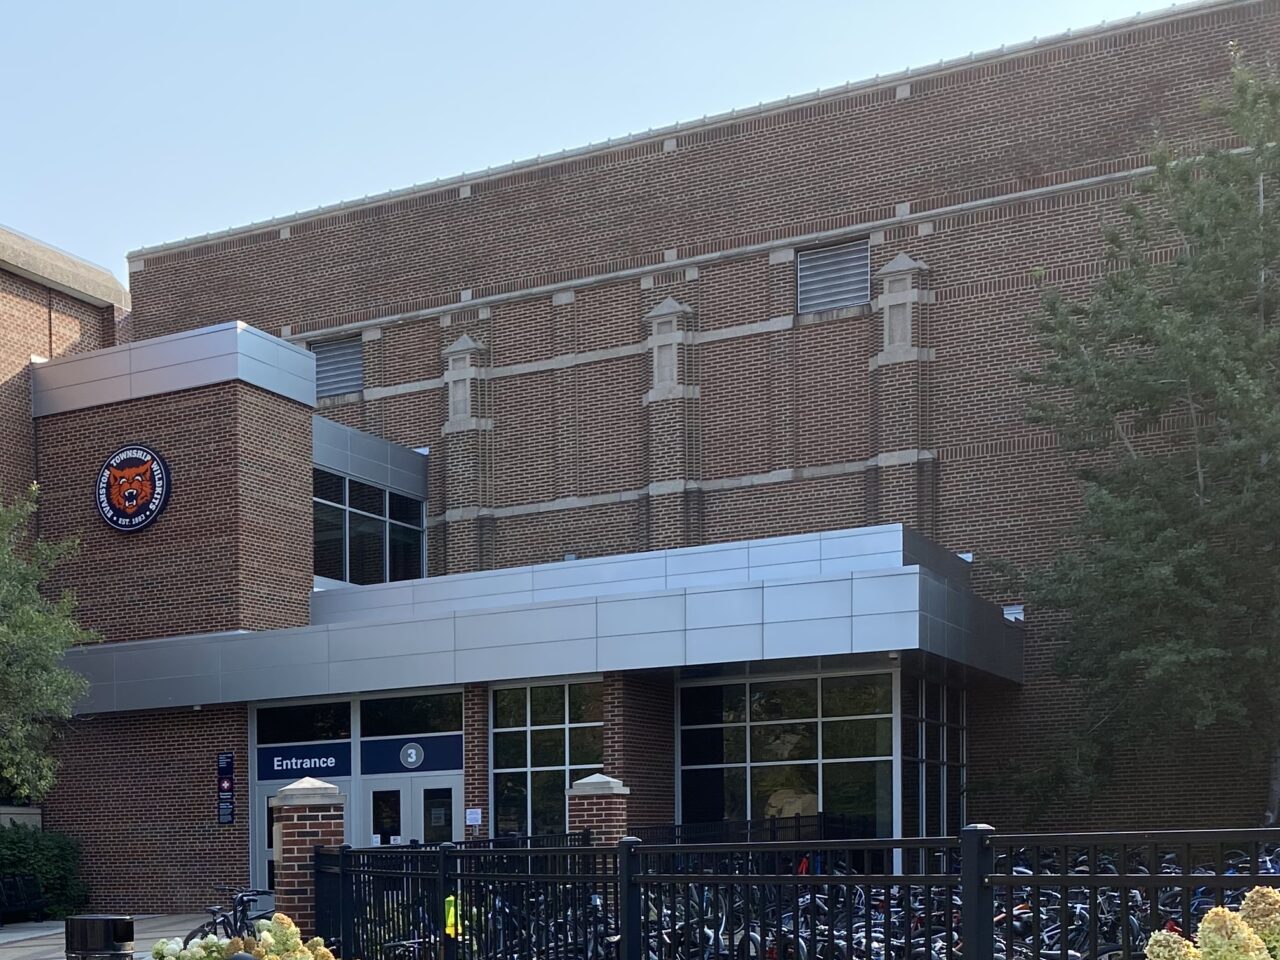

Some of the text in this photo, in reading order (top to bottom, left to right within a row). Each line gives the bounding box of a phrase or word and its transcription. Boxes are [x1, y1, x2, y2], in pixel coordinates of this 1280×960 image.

[99, 449, 163, 519] EVANSTON TOWNSHIP WILDKITS
[118, 517, 131, 526] EST.
[273, 748, 417, 770] Entrance 3
